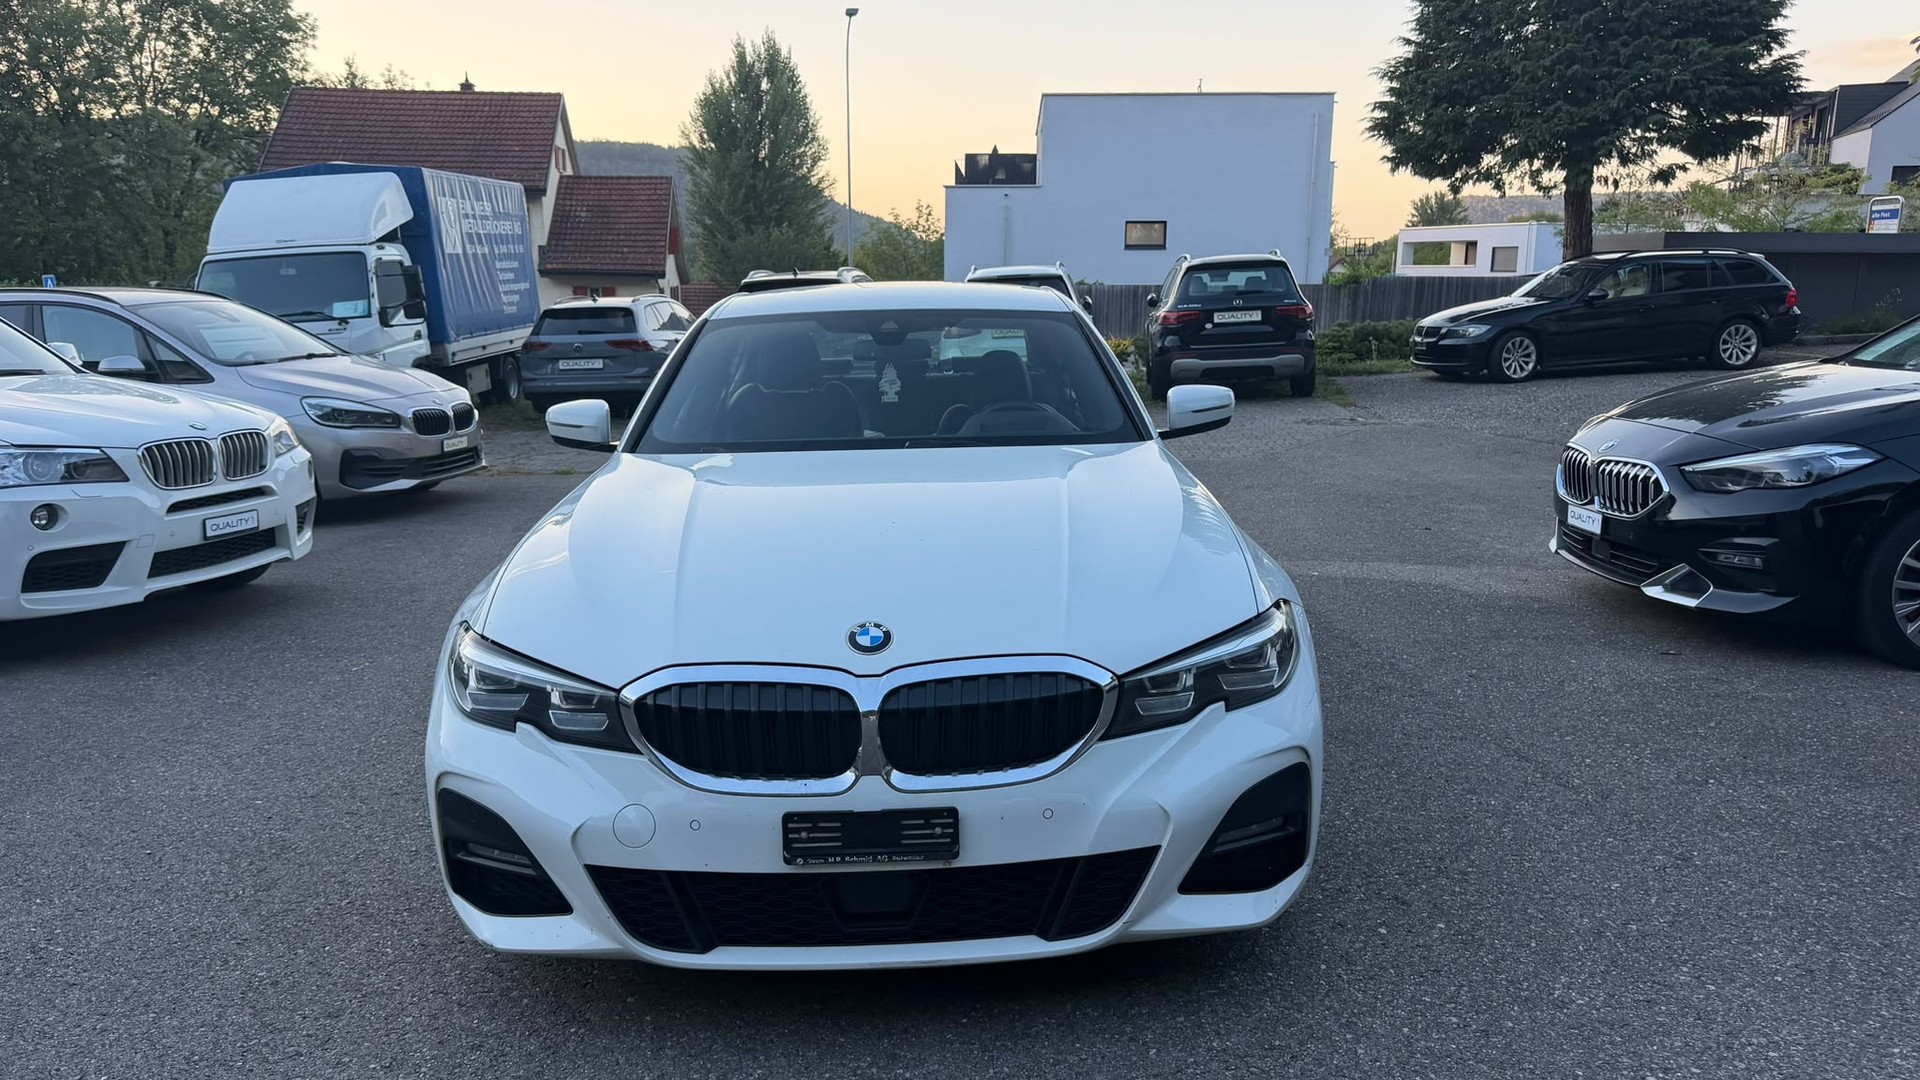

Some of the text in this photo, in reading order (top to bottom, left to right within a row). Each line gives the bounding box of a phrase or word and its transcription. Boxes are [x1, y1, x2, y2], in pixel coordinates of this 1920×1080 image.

[1216, 312, 1254, 321] QUALITY
[561, 360, 597, 368] QUALITY
[1569, 510, 1596, 526] QUALITY
[210, 517, 250, 532] QUALITY
[844, 855, 873, 864] Schmid
[876, 855, 889, 863] AG
